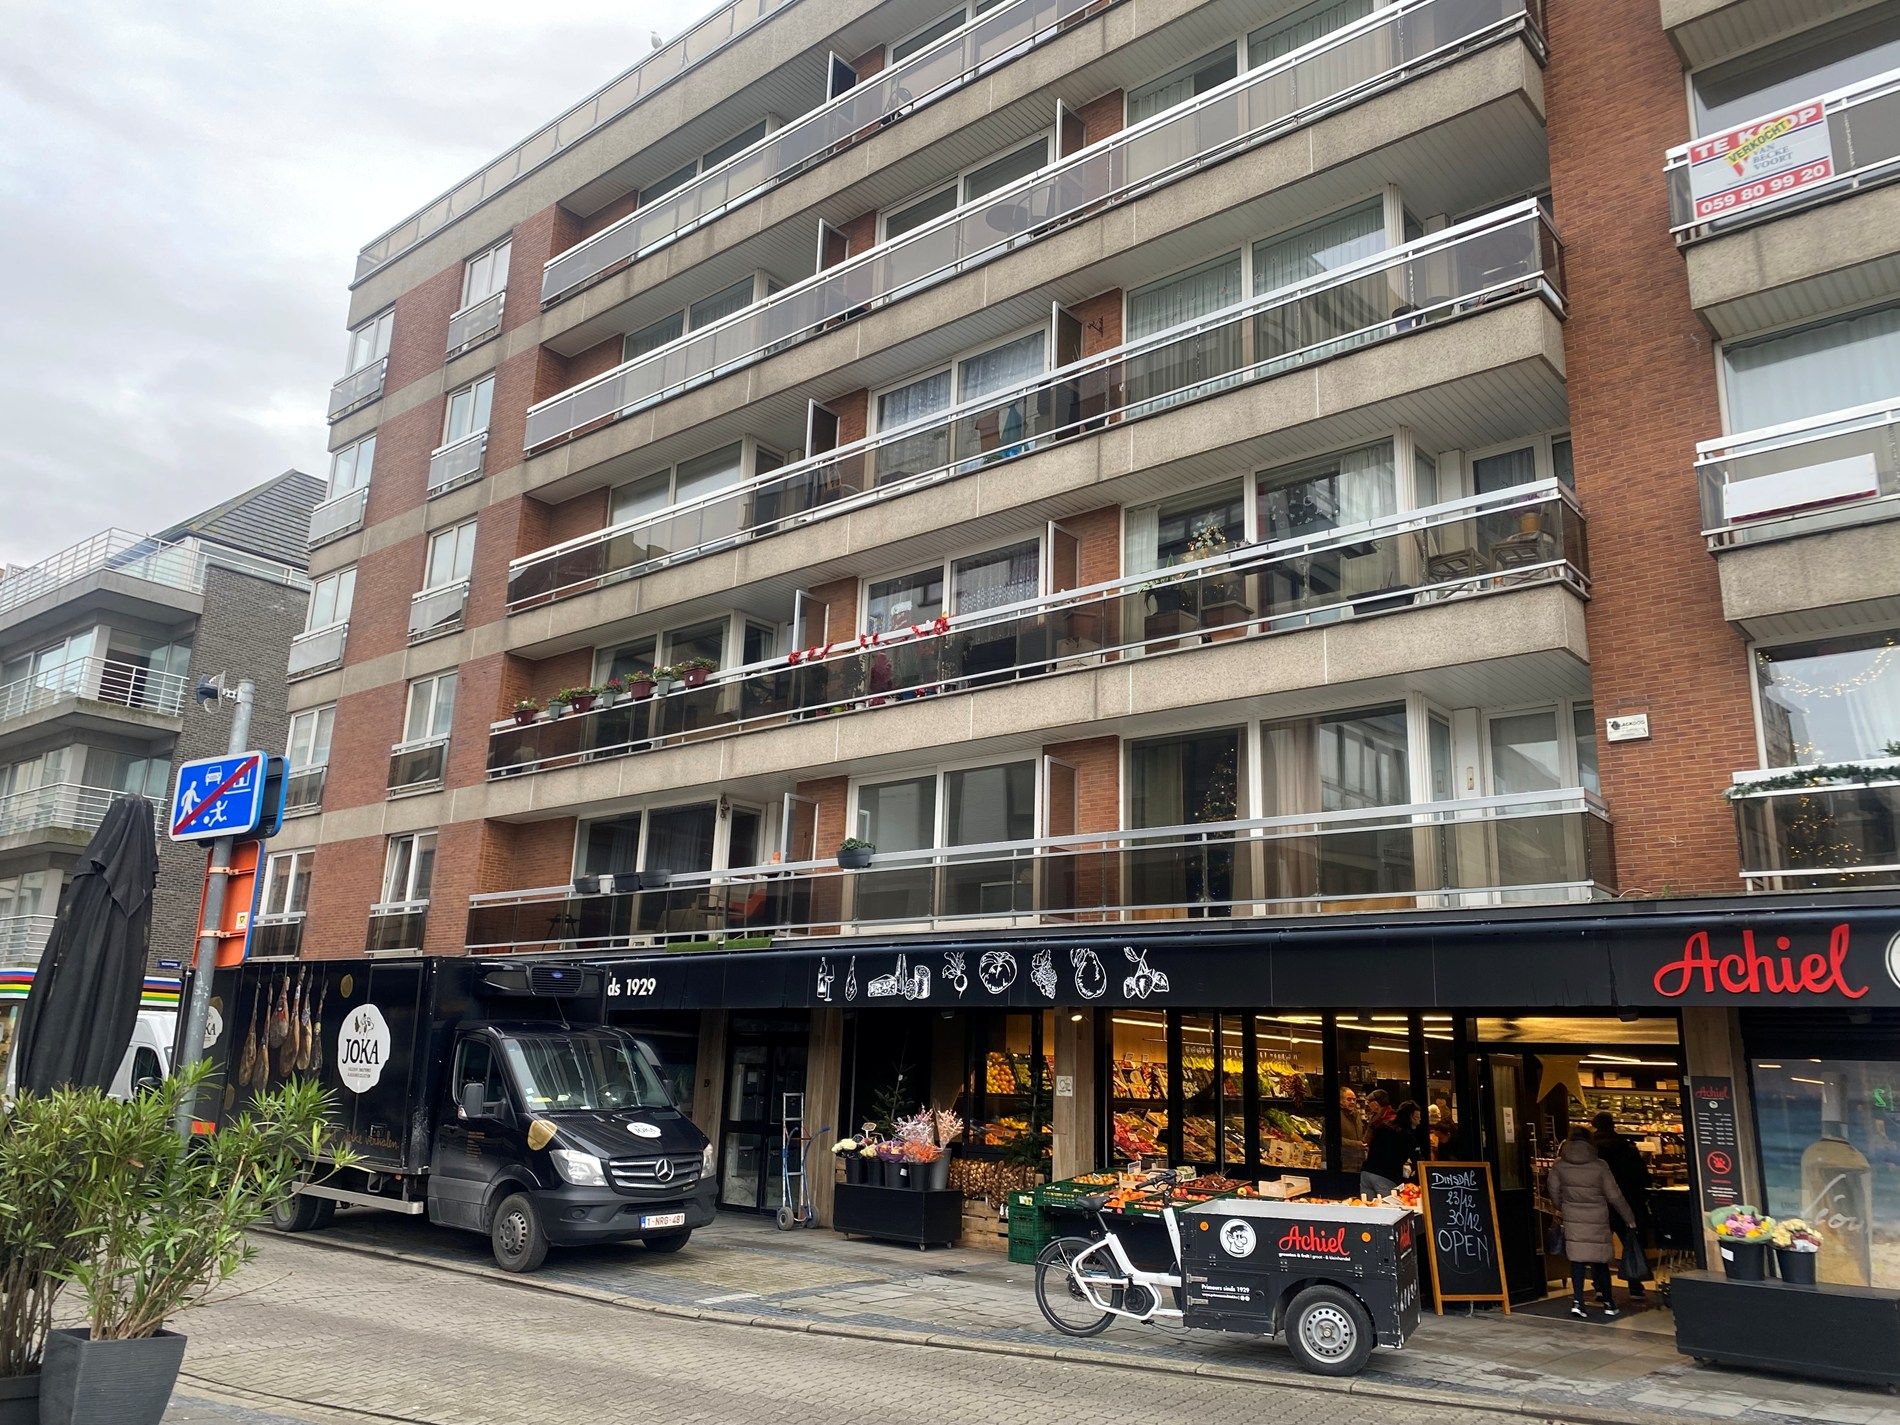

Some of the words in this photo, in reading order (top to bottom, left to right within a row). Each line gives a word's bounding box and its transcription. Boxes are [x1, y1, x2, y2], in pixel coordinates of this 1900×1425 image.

[1695, 138, 1730, 158] TE
[1728, 121, 1788, 163] VERKOCHT
[1752, 146, 1790, 163] BECKE
[1753, 152, 1794, 170] VOORT
[1701, 195, 1736, 213] 059
[1741, 185, 1765, 201] 80
[1769, 175, 1795, 191] 99
[1801, 165, 1826, 180] 20
[1653, 923, 1870, 999] Achiel
[607, 977, 621, 996] ds
[626, 977, 657, 996] 1929
[205, 1022, 216, 1036] KA
[341, 1038, 379, 1065] JOKA
[1446, 1188, 1476, 1213] 23/12
[1446, 1208, 1482, 1232] 30/12
[1279, 1224, 1350, 1256] Achiel
[1438, 1229, 1490, 1269] OPEN
[1201, 1283, 1222, 1291] Primeurs
